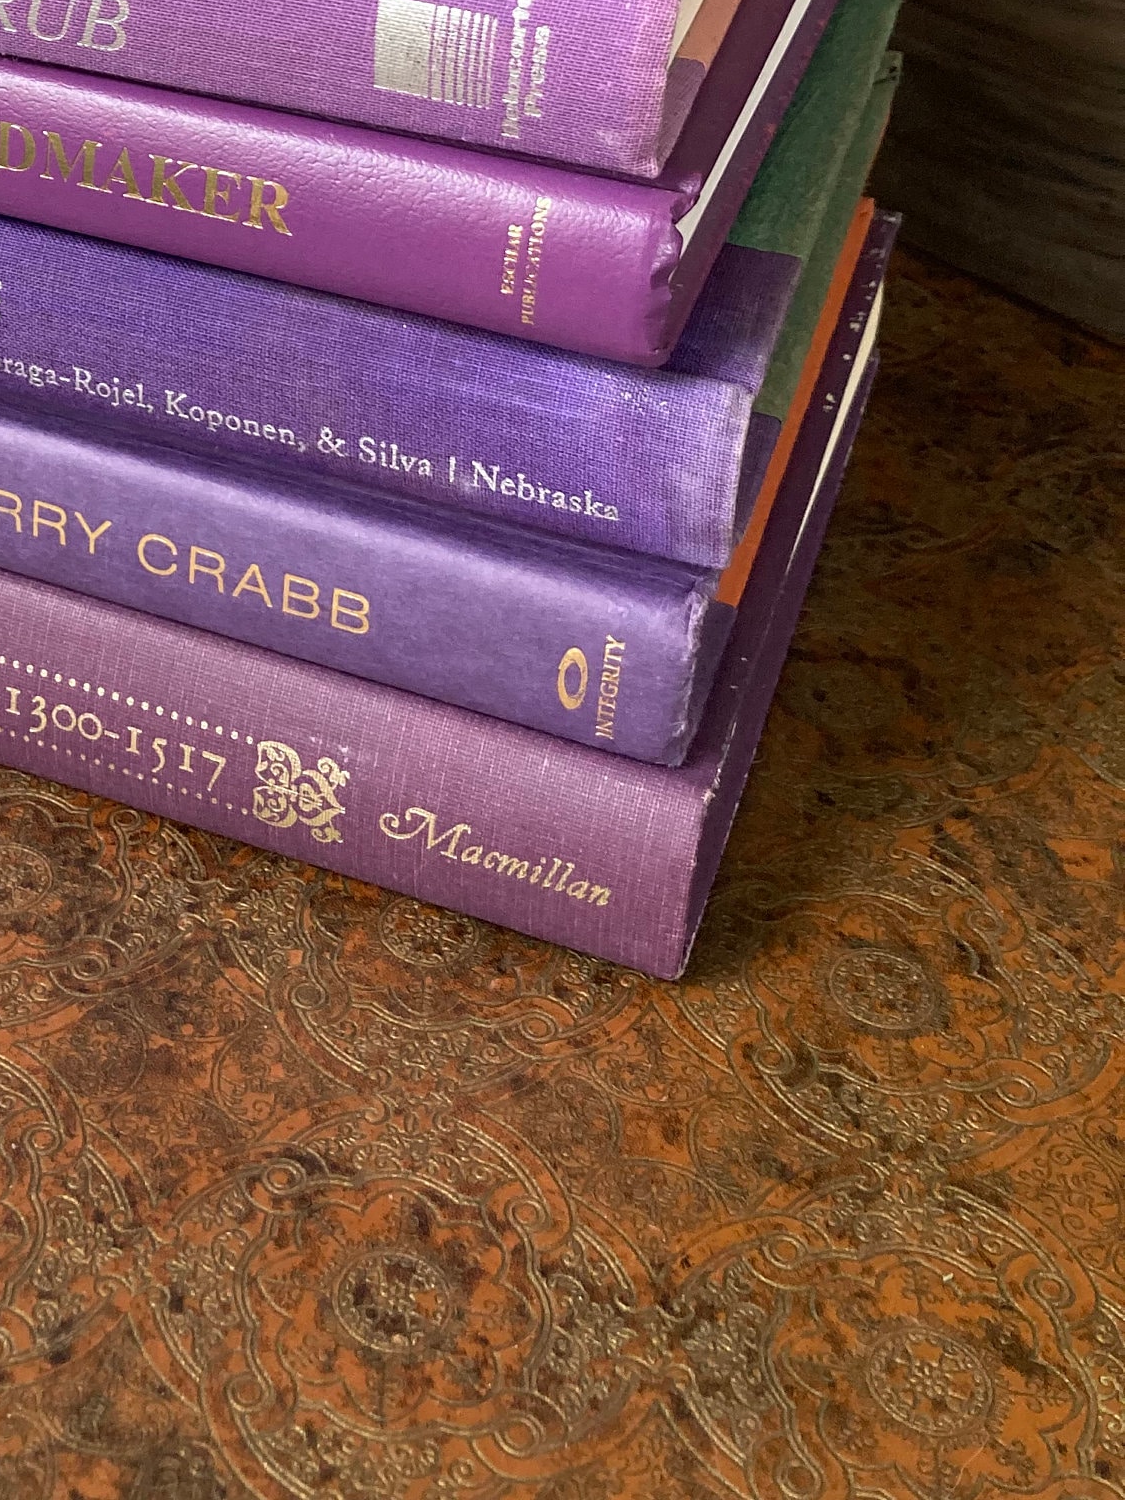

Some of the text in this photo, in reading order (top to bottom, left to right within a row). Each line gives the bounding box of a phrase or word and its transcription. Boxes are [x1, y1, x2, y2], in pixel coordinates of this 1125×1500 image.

[523, 25, 551, 119] Press
[520, 197, 553, 326] PUBLICATIONS
[164, 389, 307, 453] Koponen,
[316, 426, 347, 457] &
[358, 437, 433, 478] Silva
[471, 461, 620, 522] Nebraska
[137, 534, 371, 636] CRABB
[4, 686, 228, 794] 1300-1517
[595, 634, 626, 740] INTEGRITY
[379, 807, 613, 907] Macmillan
